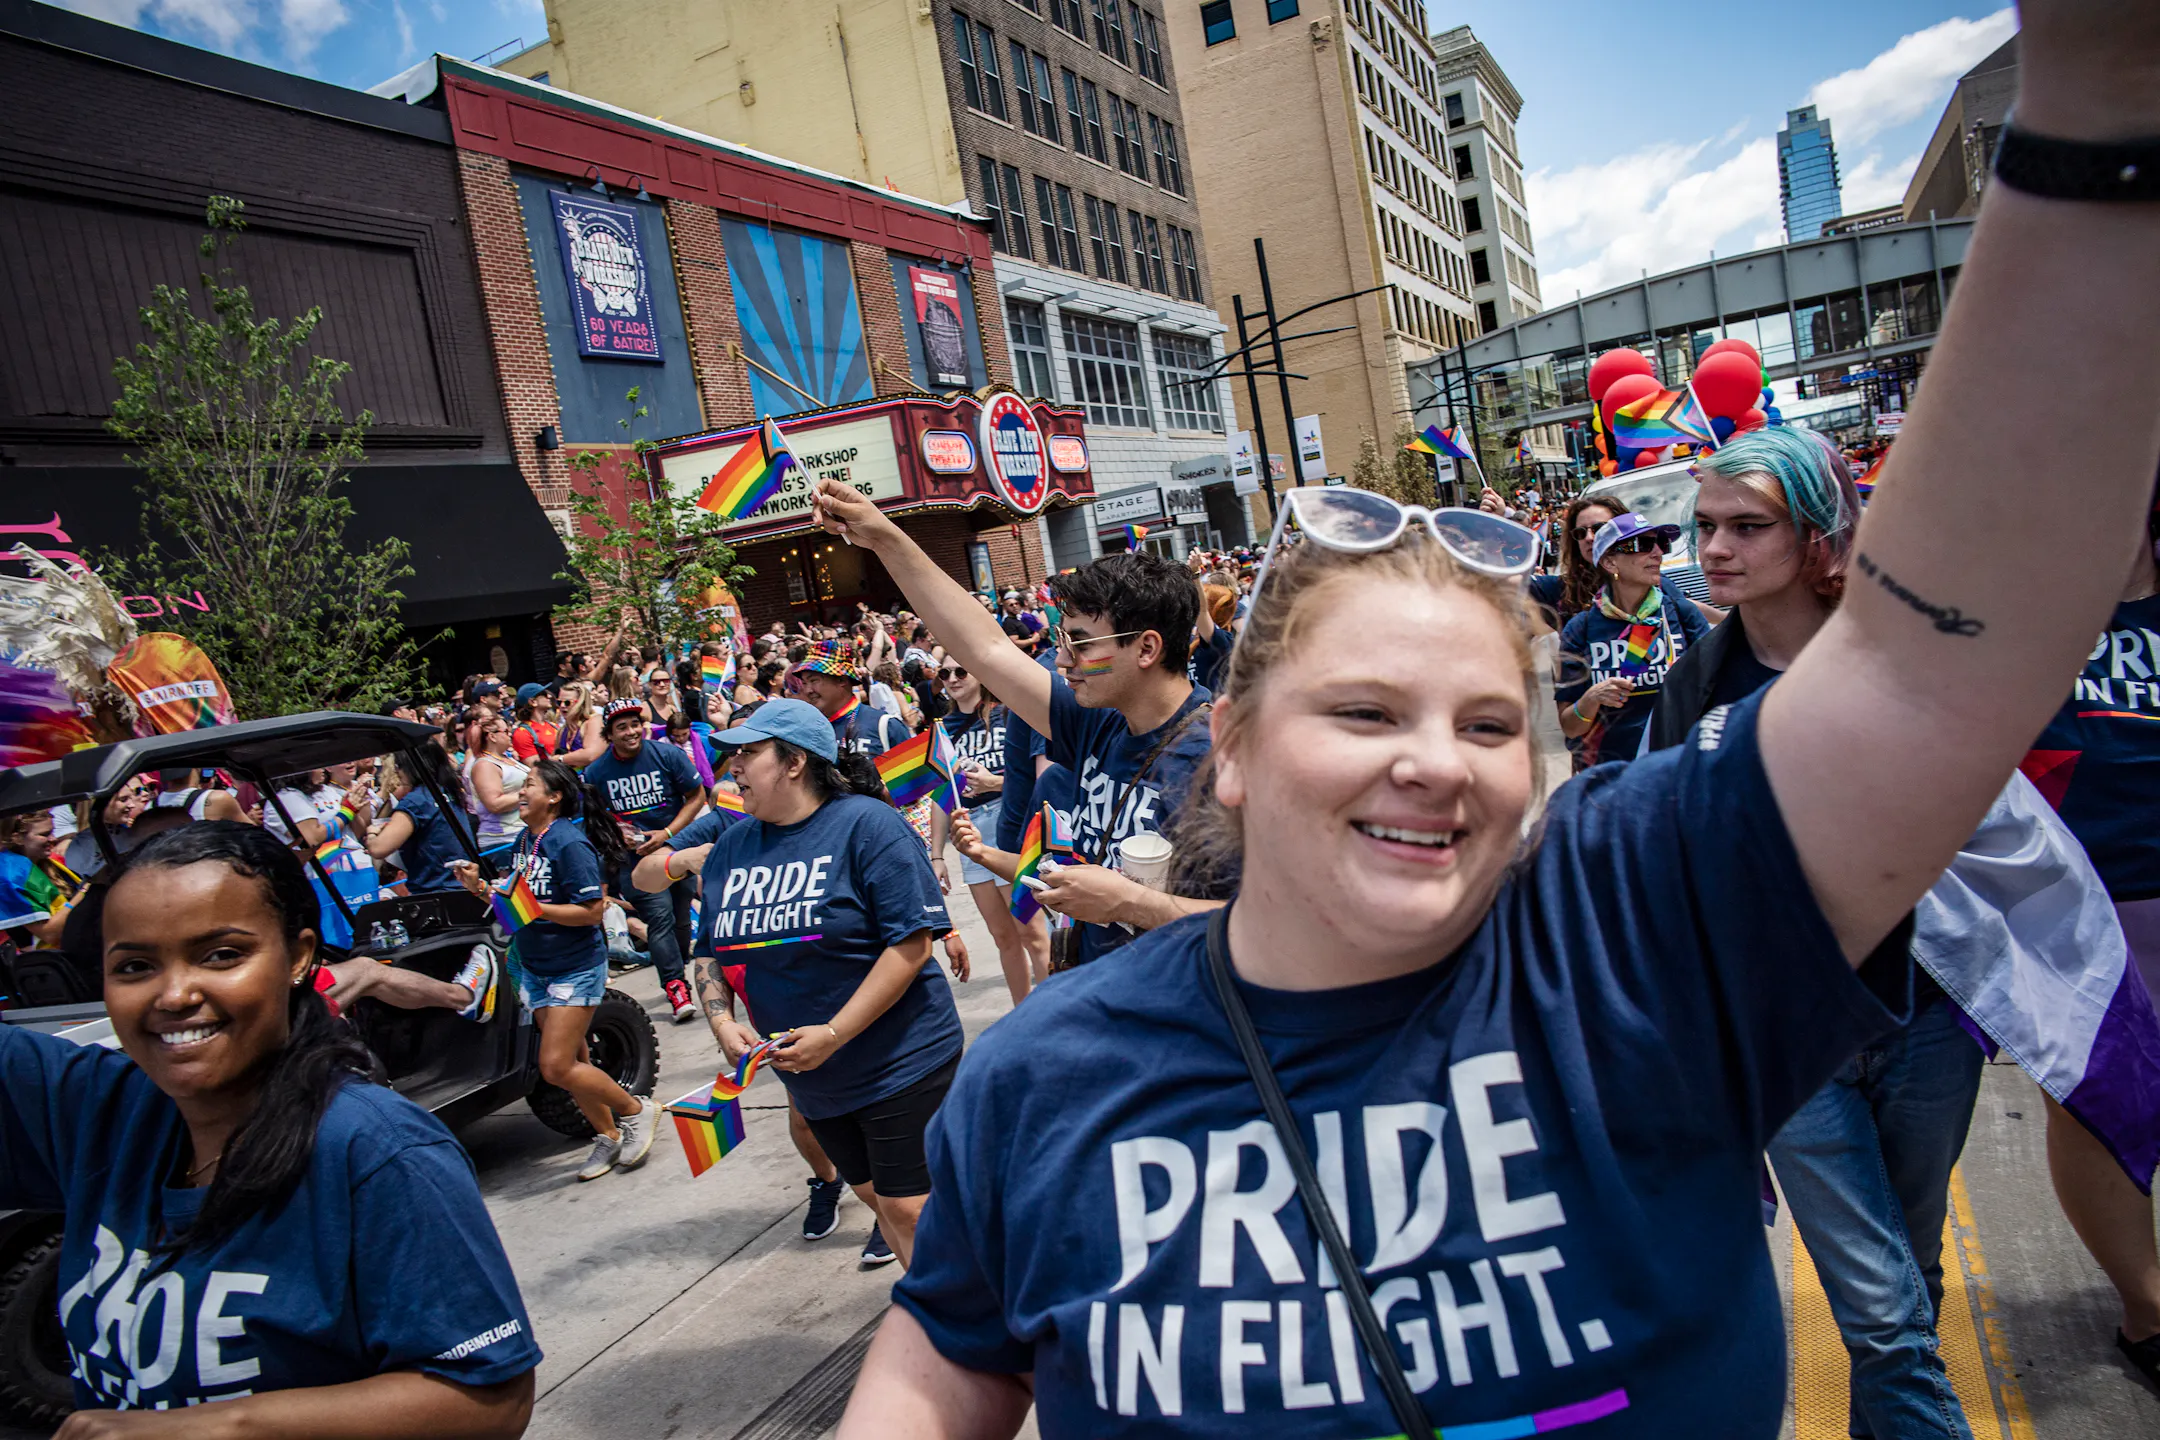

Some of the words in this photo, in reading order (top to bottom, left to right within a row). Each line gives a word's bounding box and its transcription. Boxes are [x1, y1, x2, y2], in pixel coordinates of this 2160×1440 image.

[578, 238, 611, 261] BRAVE
[609, 240, 635, 266] NEW
[582, 261, 637, 289] WORKSHOP
[590, 316, 606, 331] 60
[609, 319, 648, 335] YEARS
[590, 333, 607, 348] OF
[613, 336, 655, 352] SATIRE!
[996, 454, 1043, 480] WORKSHOP
[1177, 466, 1217, 481] SMOKES
[1096, 496, 1144, 512] STAGE
[1106, 505, 1159, 520] APARTMENTS
[2074, 676, 2115, 705] IN
[607, 770, 664, 799] PRIDE
[612, 798, 625, 811] IN
[625, 790, 667, 810] FLIGHT.
[721, 855, 832, 908] PRIDE
[714, 909, 737, 939] IN
[739, 899, 823, 936] FLIGHT.
[1108, 1050, 1567, 1295] PRIDE
[1088, 1301, 1185, 1417] IN
[1219, 1245, 1614, 1415] FLIGHT.
